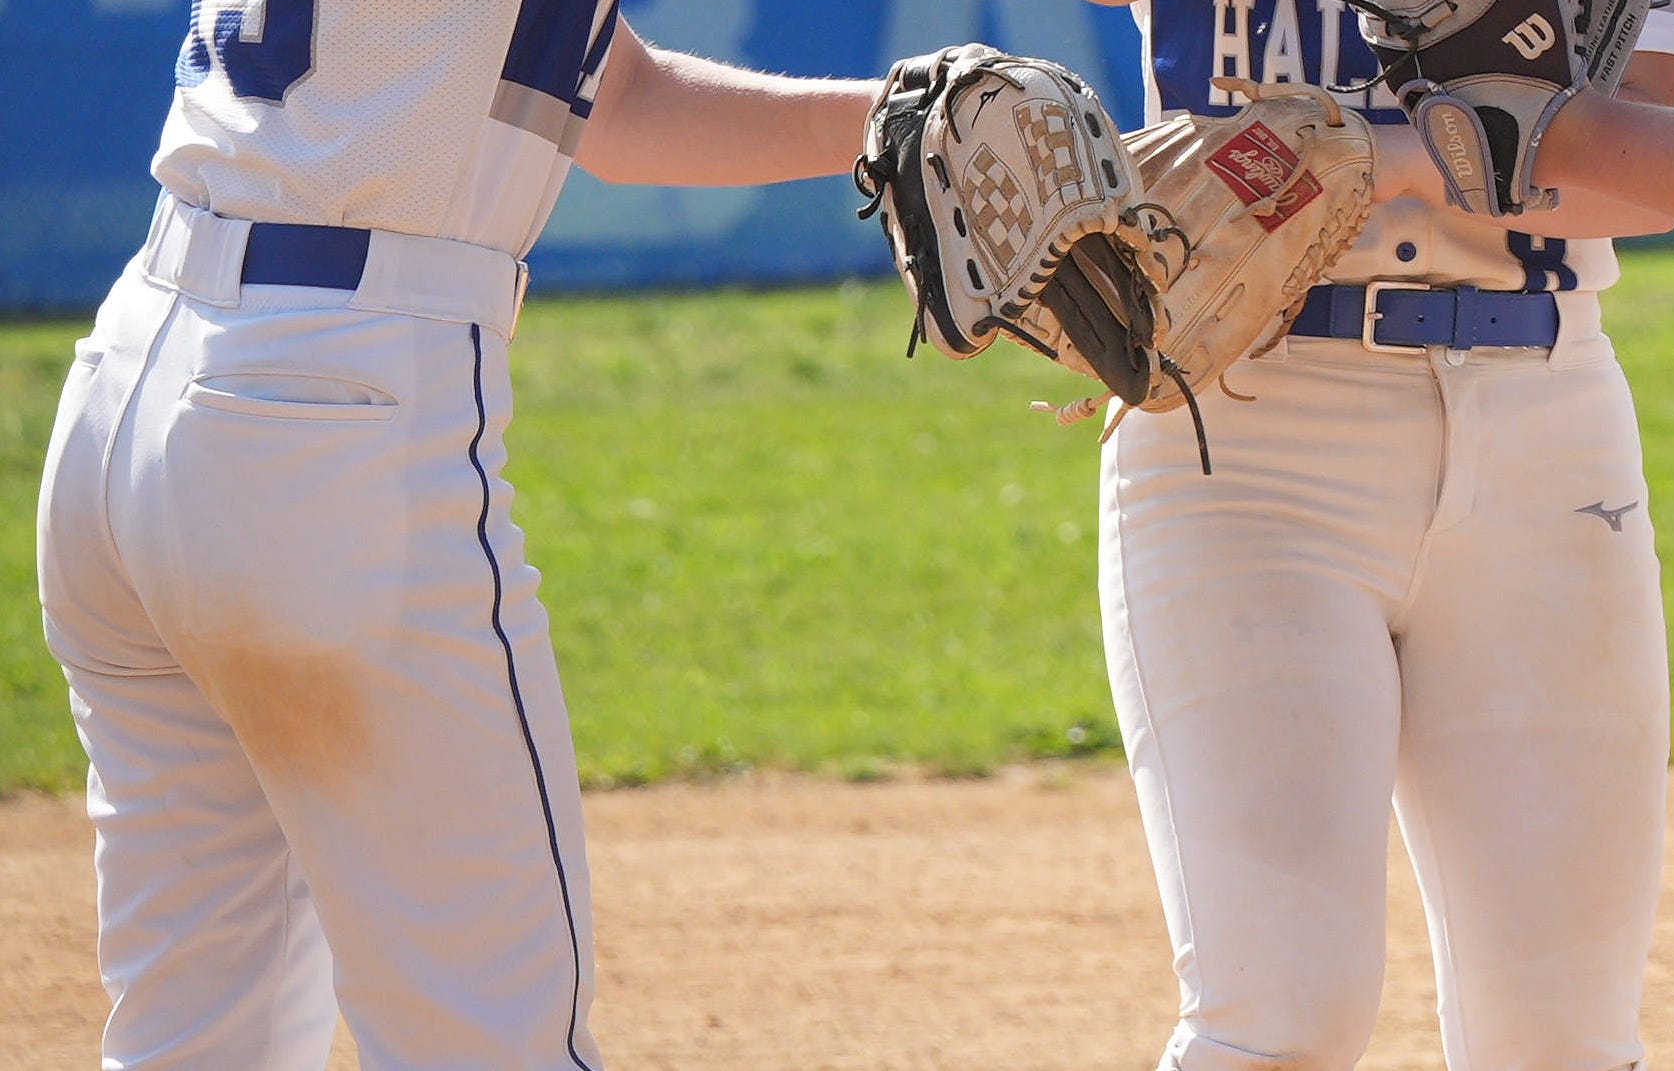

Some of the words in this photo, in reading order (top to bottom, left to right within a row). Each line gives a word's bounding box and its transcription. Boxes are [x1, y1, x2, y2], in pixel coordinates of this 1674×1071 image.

[1600, 51, 1617, 81] FAST
[1616, 13, 1636, 50] PITCH
[1442, 113, 1472, 178] Wilson
